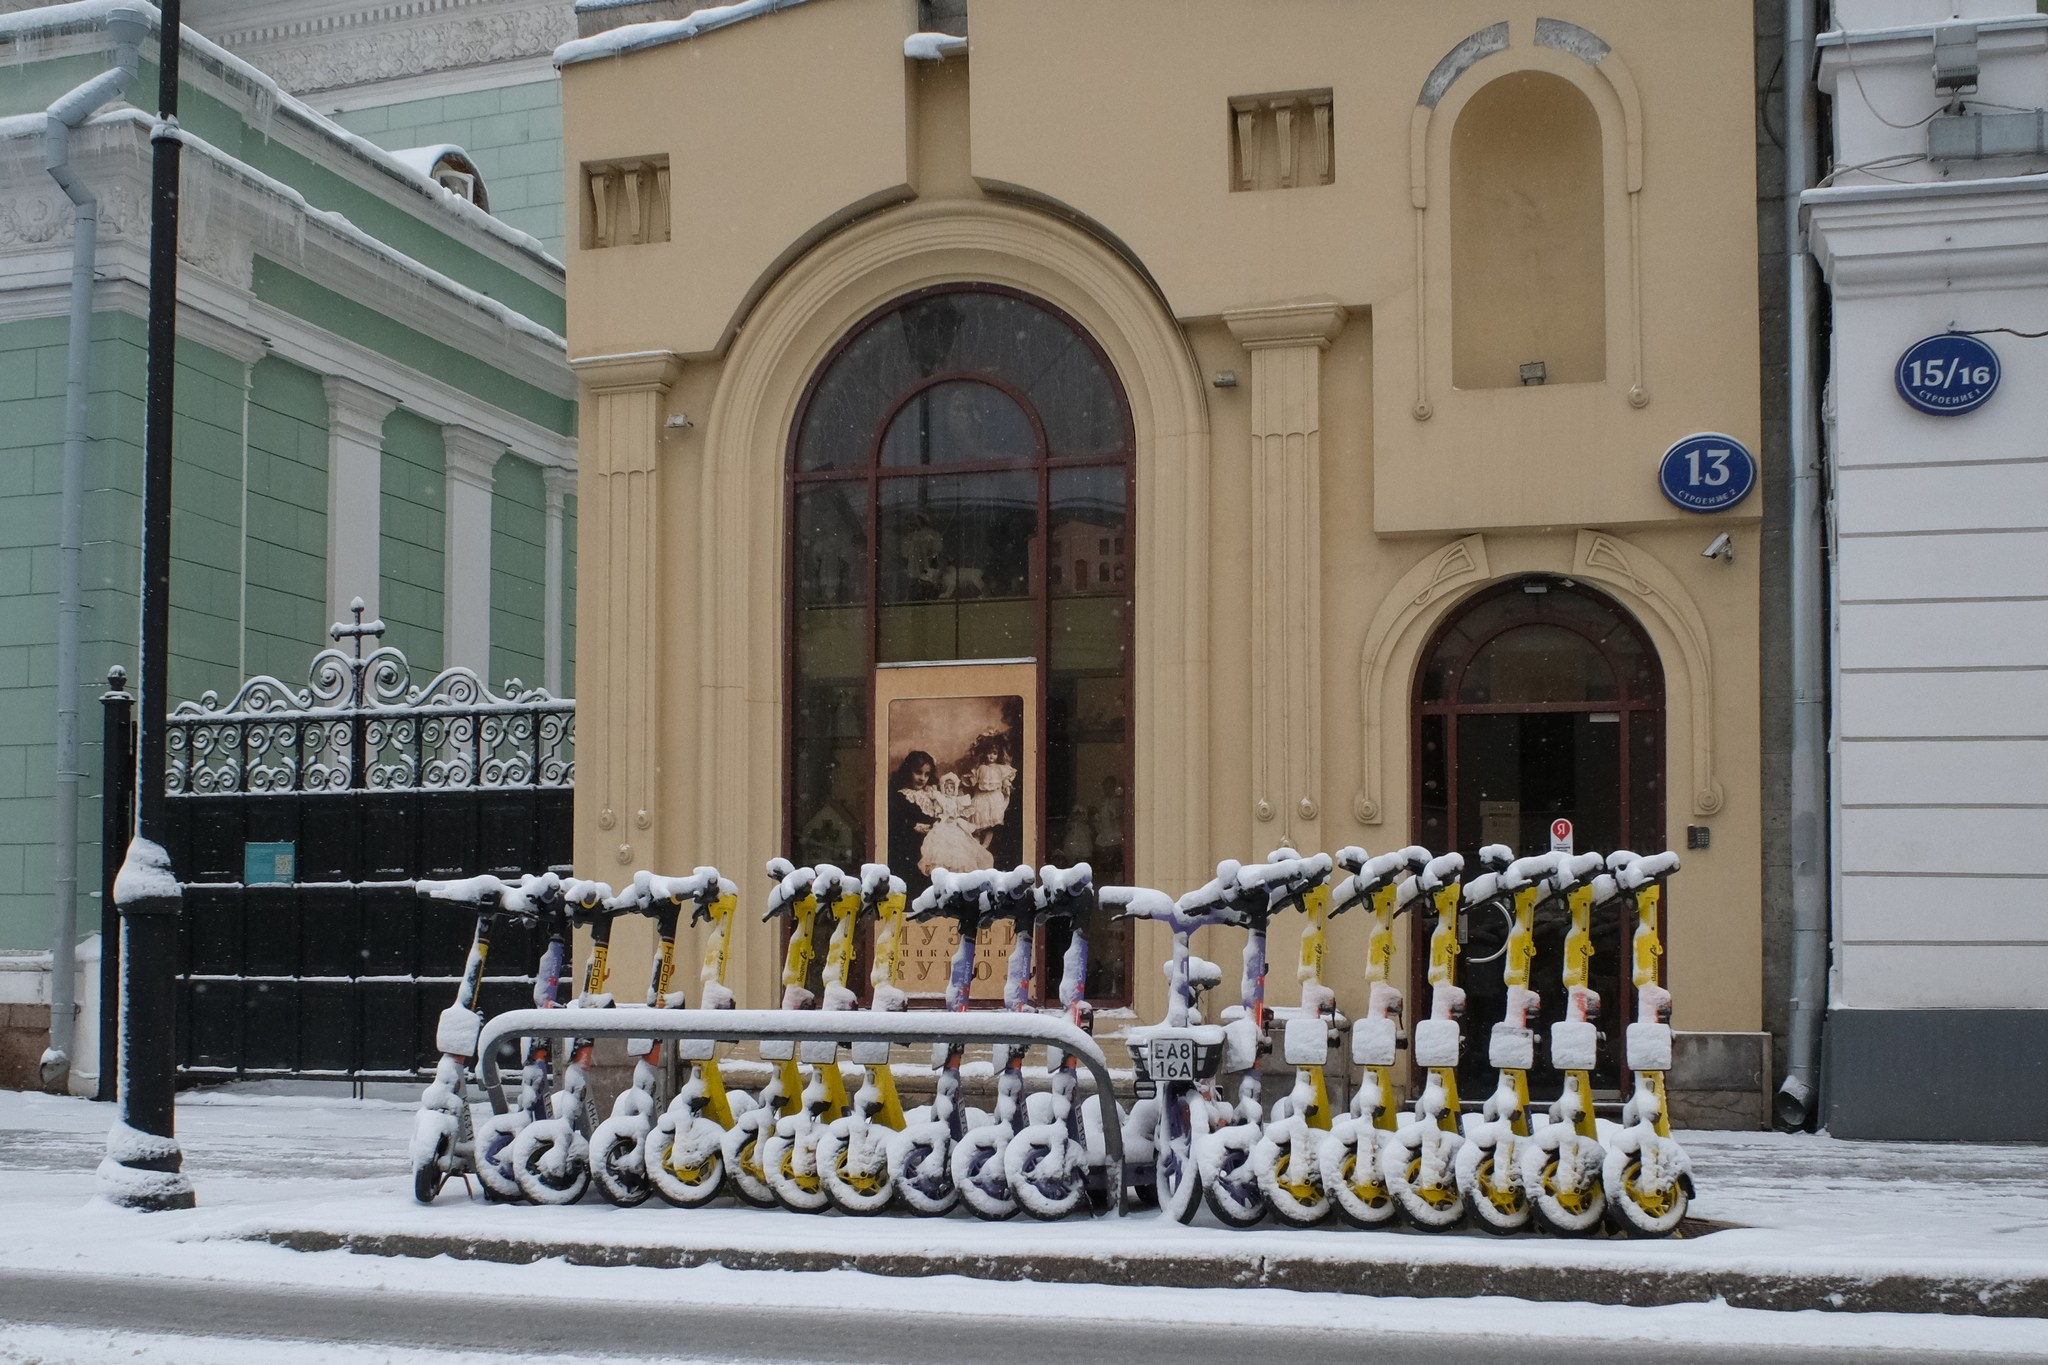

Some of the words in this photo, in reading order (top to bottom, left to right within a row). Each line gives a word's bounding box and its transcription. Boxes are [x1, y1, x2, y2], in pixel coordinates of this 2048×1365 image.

[1909, 357, 1991, 389] 15/16
[1919, 390, 1975, 404] СТРОЕНИЕ
[1684, 449, 1730, 486] 13
[1678, 490, 1729, 505] СТРОЕНИЕ
[1729, 488, 1736, 496] 2
[1155, 1043, 1190, 1059] EA8
[1156, 1061, 1191, 1078] 16A
